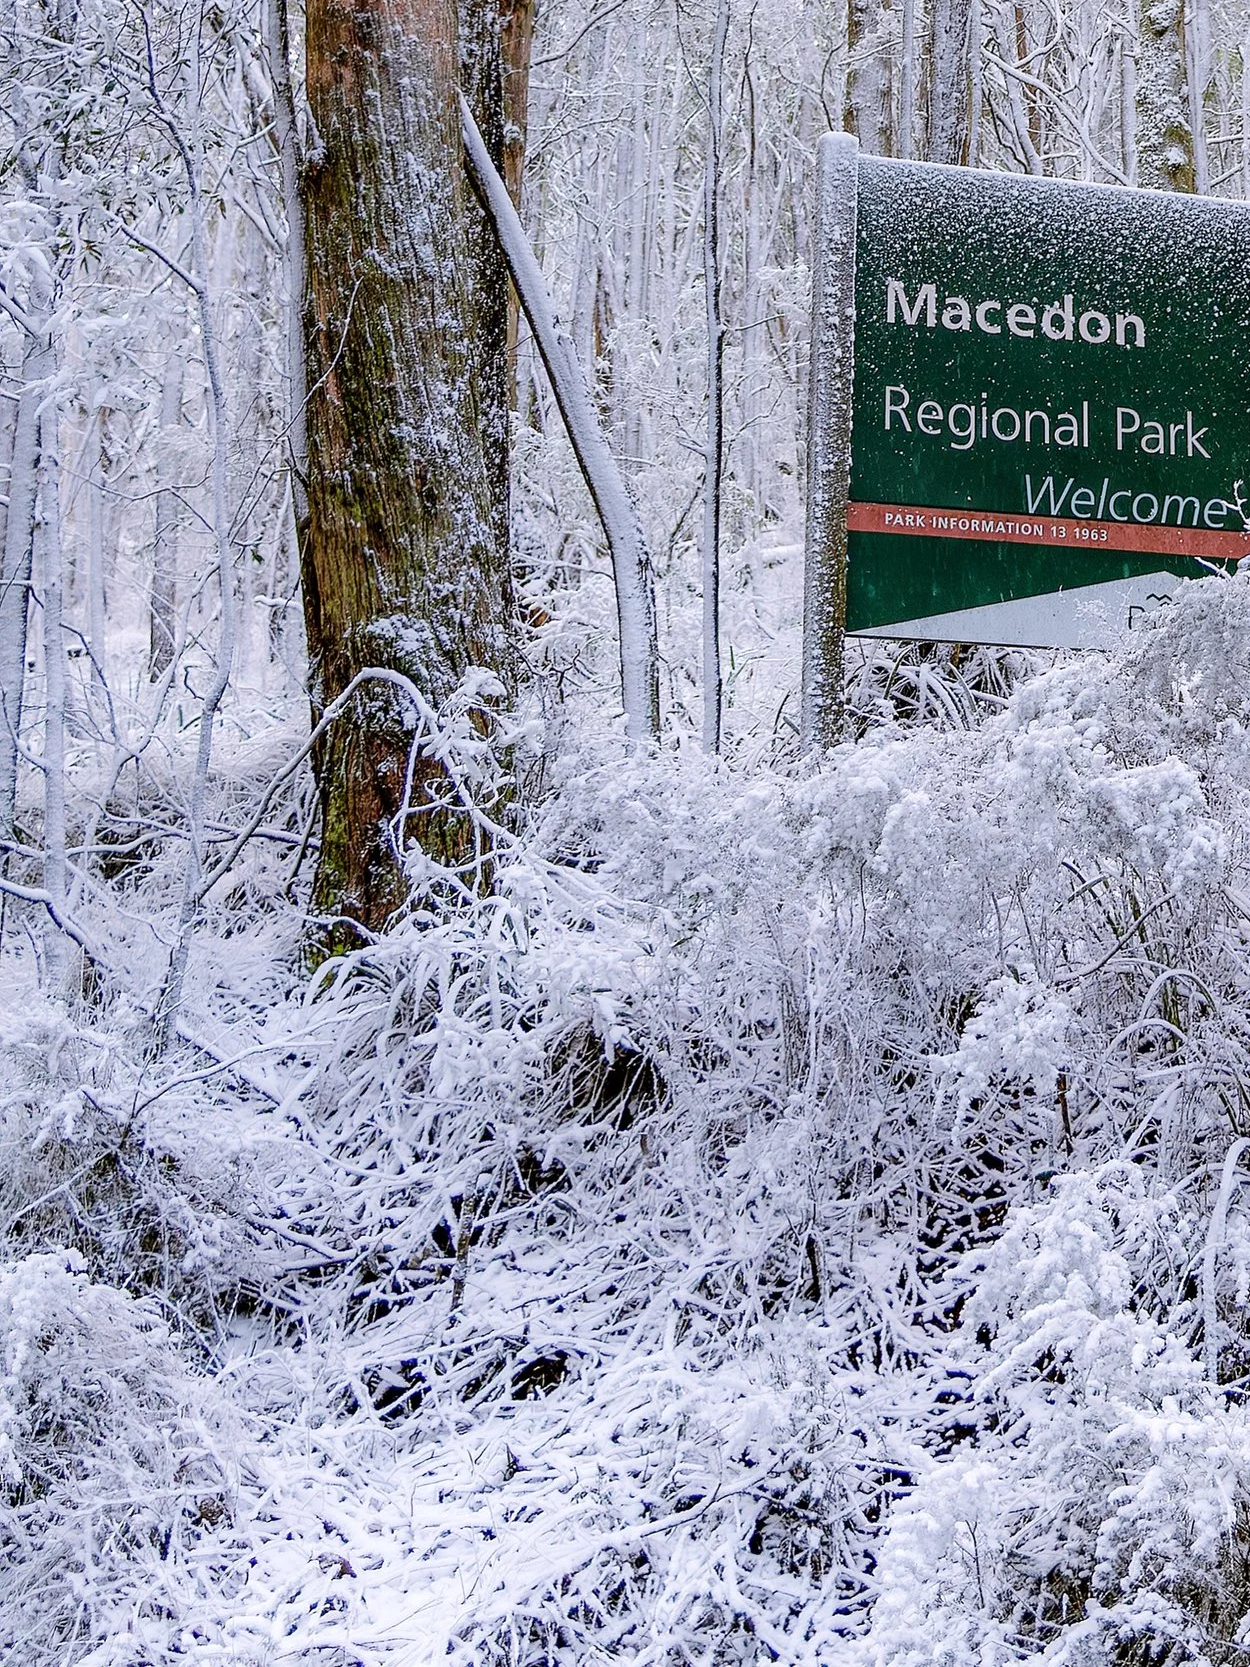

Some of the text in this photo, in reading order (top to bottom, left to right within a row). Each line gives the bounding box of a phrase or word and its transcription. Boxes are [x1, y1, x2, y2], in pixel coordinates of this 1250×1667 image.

[886, 278, 1146, 347] Macedon
[884, 385, 1211, 459] Regional Park
[884, 512, 1108, 541] PARK INFORMATION 13 1963
[1025, 474, 1227, 528] Welcome
